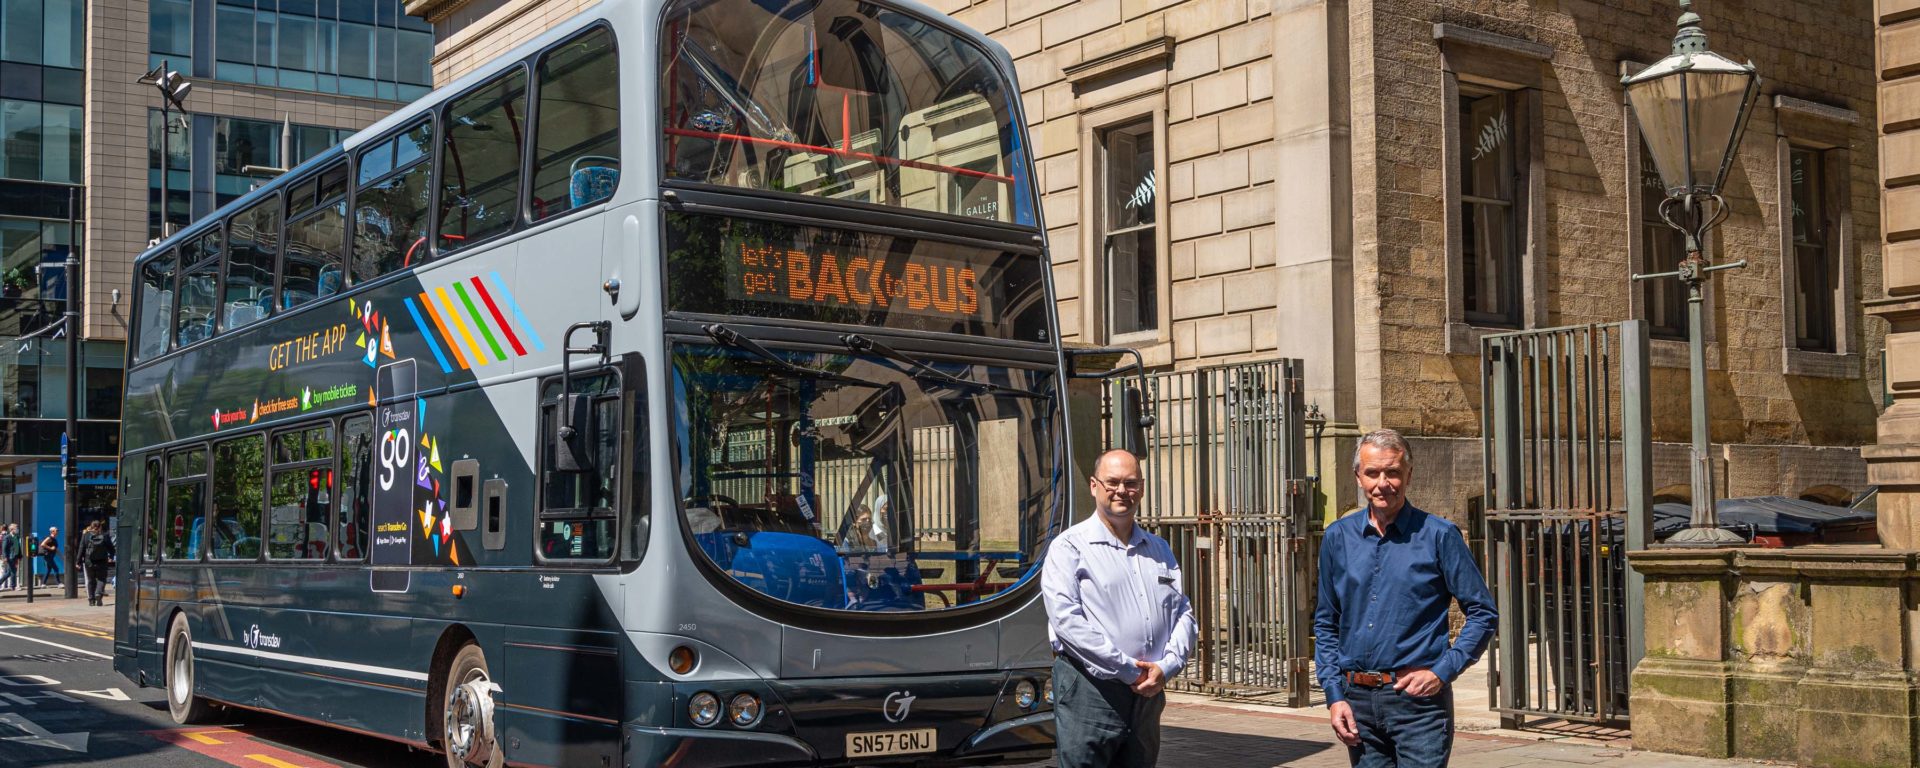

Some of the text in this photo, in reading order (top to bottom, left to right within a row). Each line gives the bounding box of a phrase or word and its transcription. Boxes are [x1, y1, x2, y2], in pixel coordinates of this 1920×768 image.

[966, 201, 998, 216] GALLER
[741, 242, 783, 269] let's
[743, 272, 777, 296] get
[787, 250, 978, 314] BACK to BUS
[269, 323, 347, 371] GET THE APP
[313, 382, 357, 406] buy mobile tickets
[259, 401, 272, 416] check
[278, 397, 287, 411] free
[287, 397, 299, 409] seats
[390, 409, 411, 422] transdev
[380, 428, 410, 491] go
[679, 623, 697, 631] 2450
[243, 630, 281, 648] by transdev
[852, 732, 930, 754] SN57 GNJ
